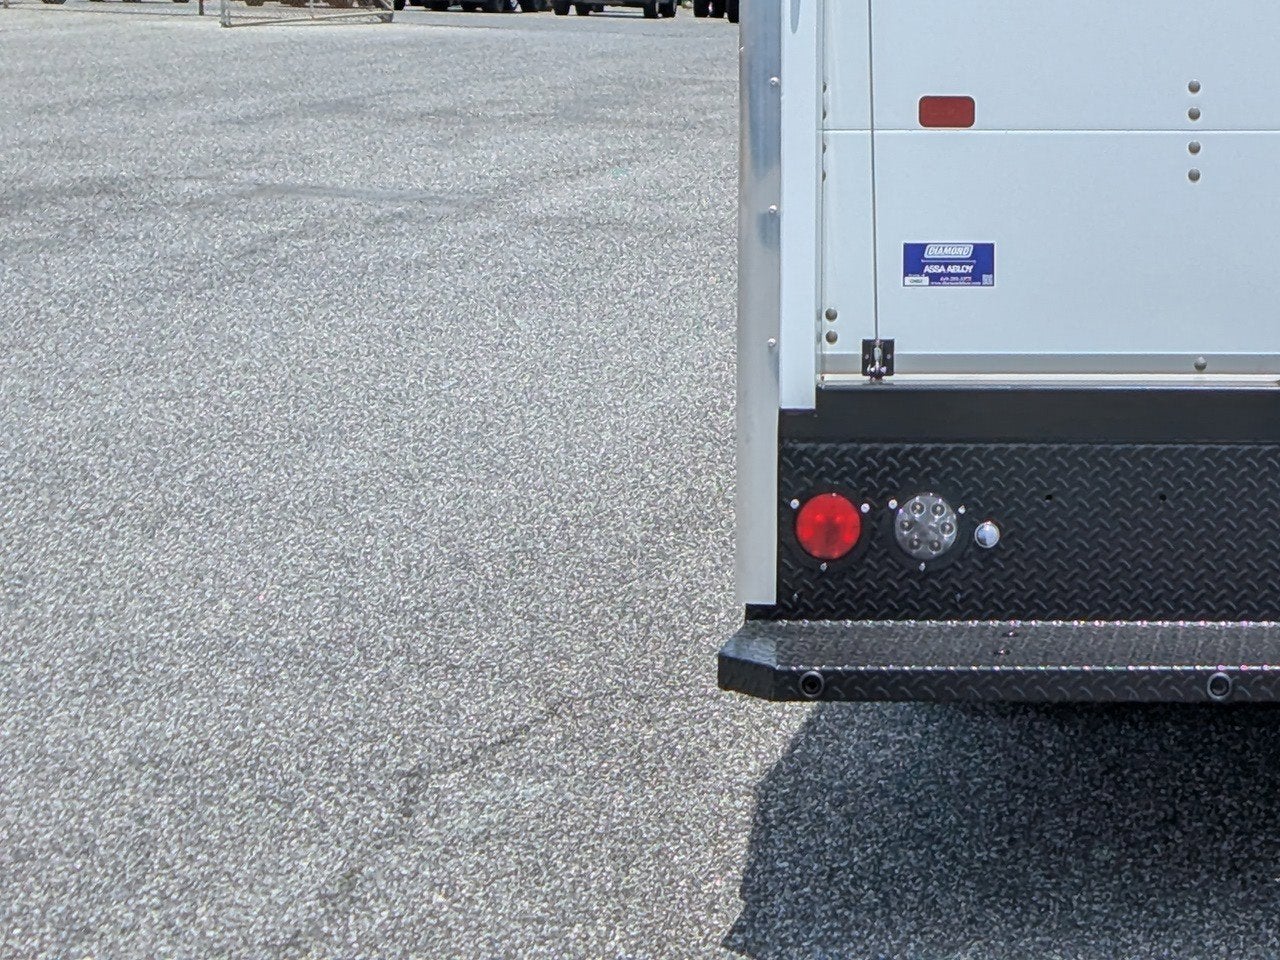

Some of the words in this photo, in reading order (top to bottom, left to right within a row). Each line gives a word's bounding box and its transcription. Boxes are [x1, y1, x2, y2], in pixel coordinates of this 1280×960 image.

[928, 245, 970, 256] DIAMOND
[923, 264, 945, 273] ASSA
[947, 264, 973, 273] ABLOY
